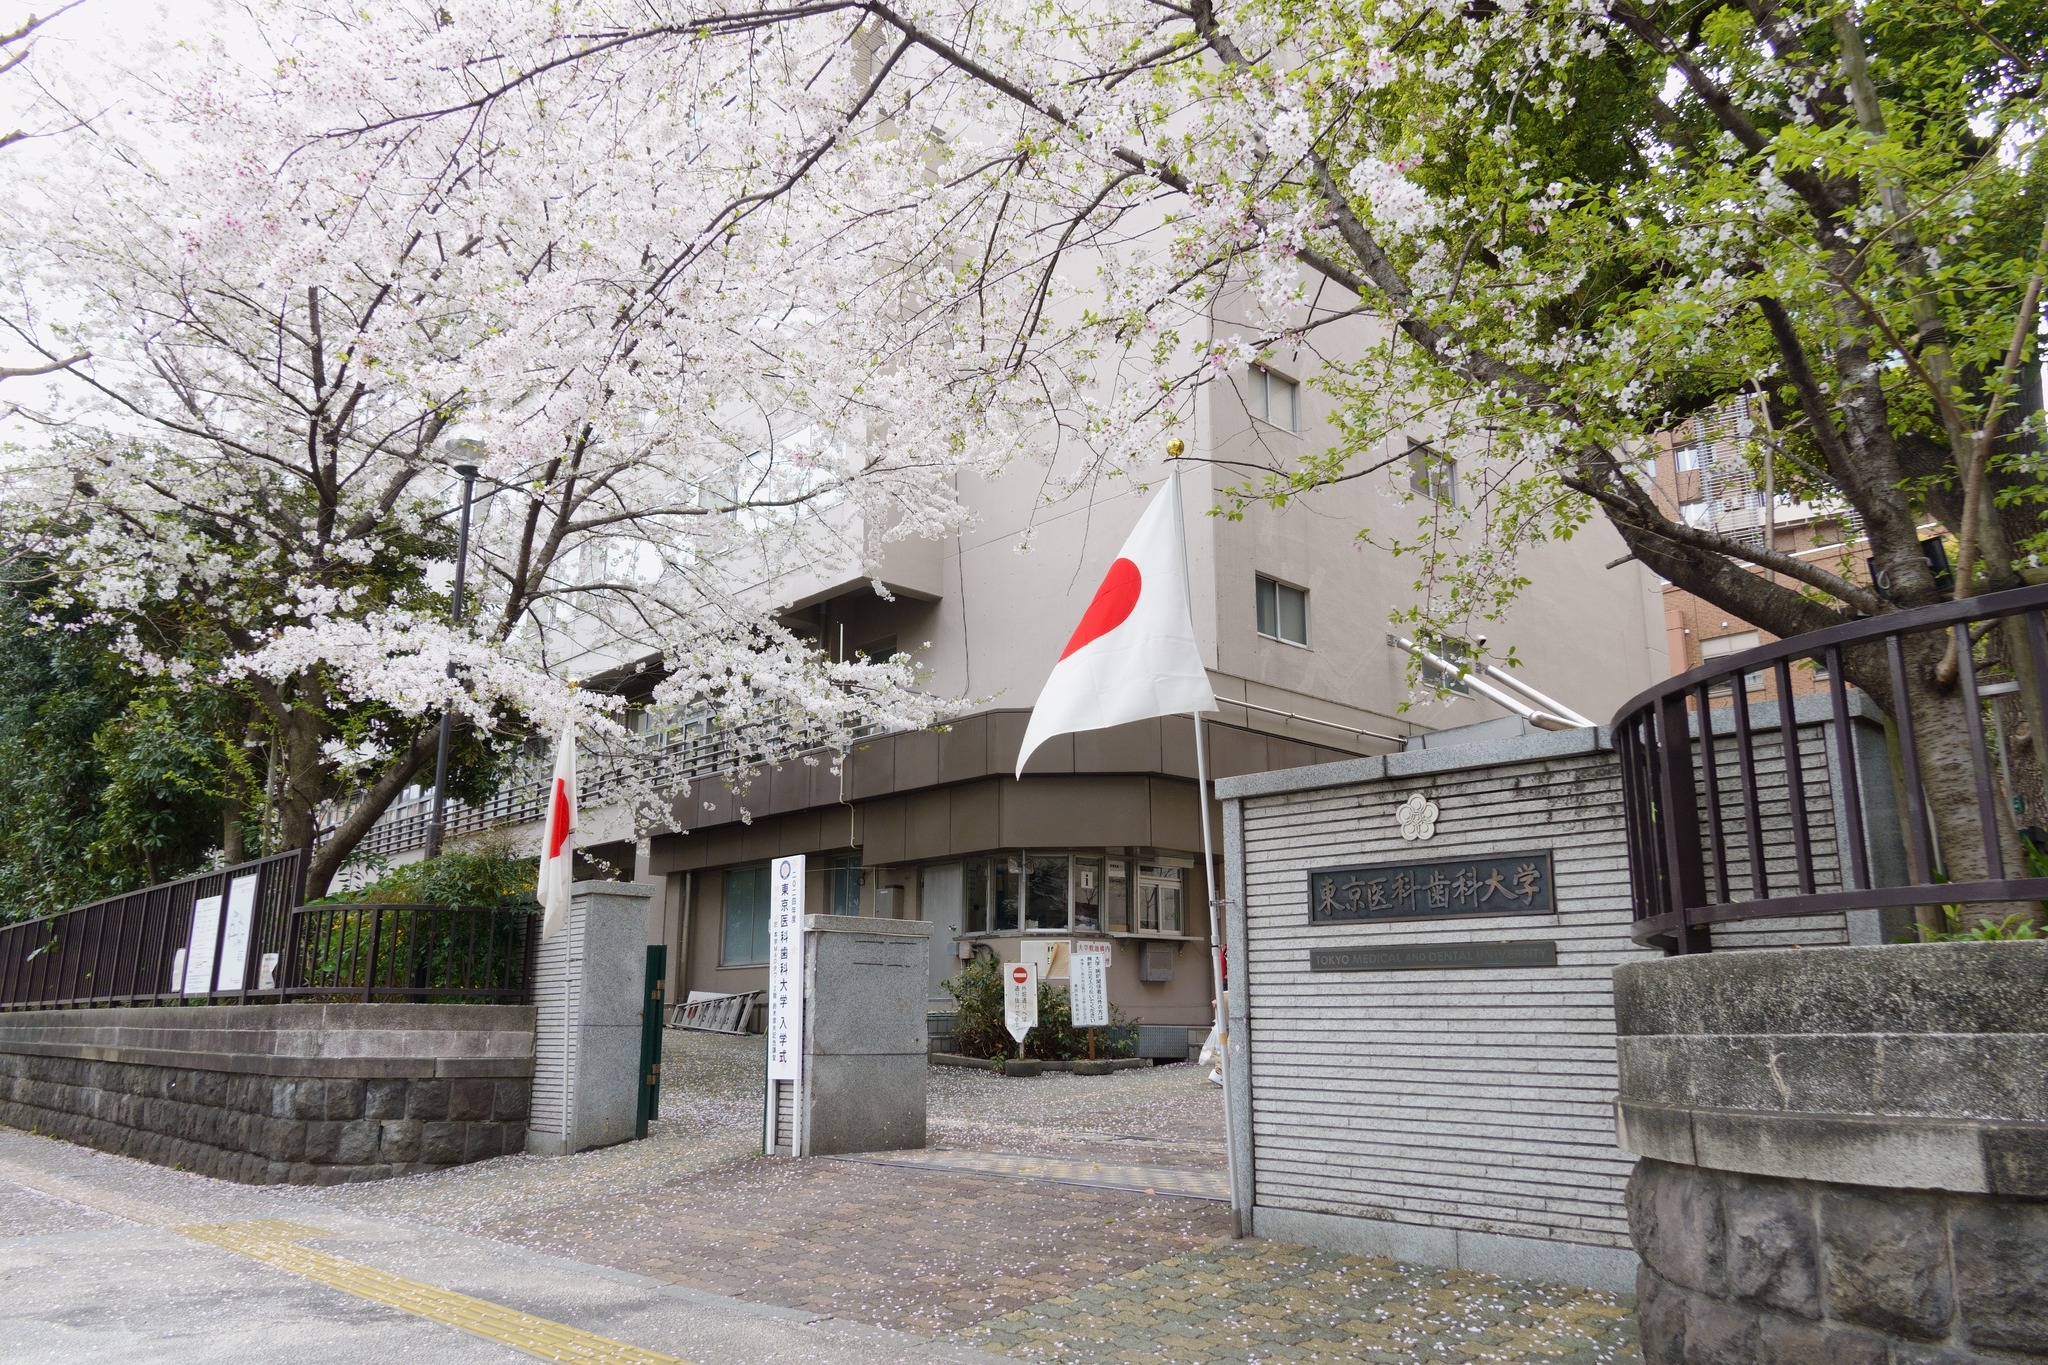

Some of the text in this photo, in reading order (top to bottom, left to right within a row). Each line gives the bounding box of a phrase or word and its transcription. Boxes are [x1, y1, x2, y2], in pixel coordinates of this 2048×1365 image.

[1318, 862, 1541, 916] 東京医科歯科大学
[779, 883, 789, 1063] 東京医科歯科大学 入学式
[1316, 947, 1547, 966] TOKYO MEDICAL AND DENTAL UNIVERSITY
